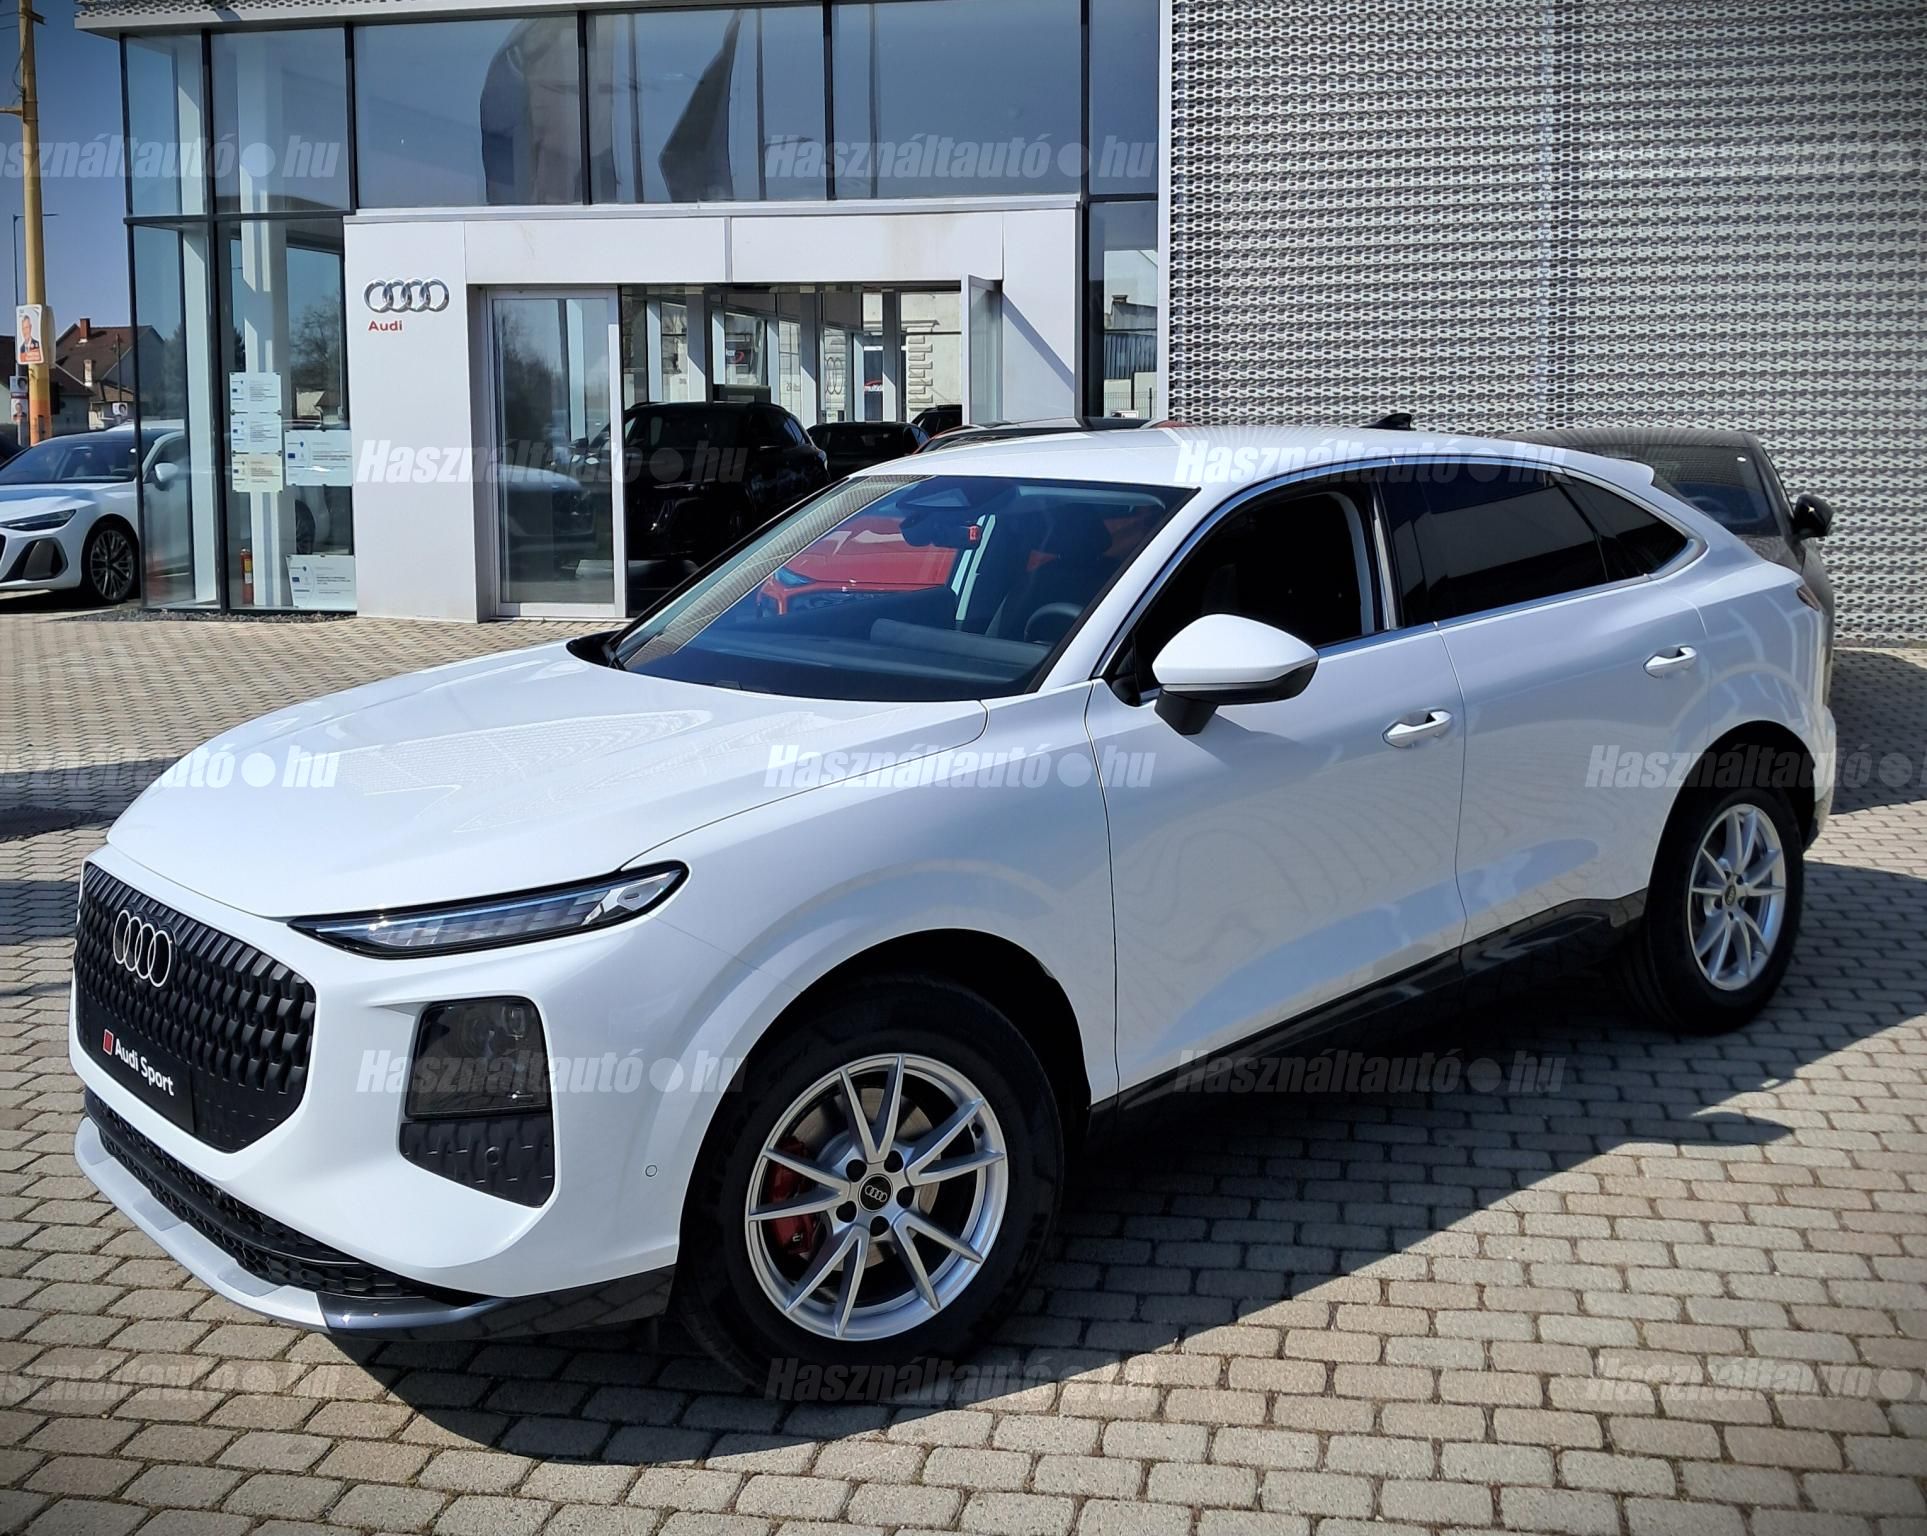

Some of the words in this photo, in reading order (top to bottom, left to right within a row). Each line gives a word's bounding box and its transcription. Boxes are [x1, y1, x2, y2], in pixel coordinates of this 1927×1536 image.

[368, 320, 403, 331] Audi
[115, 1038, 139, 1071] Audi
[140, 1056, 175, 1096] Sport
